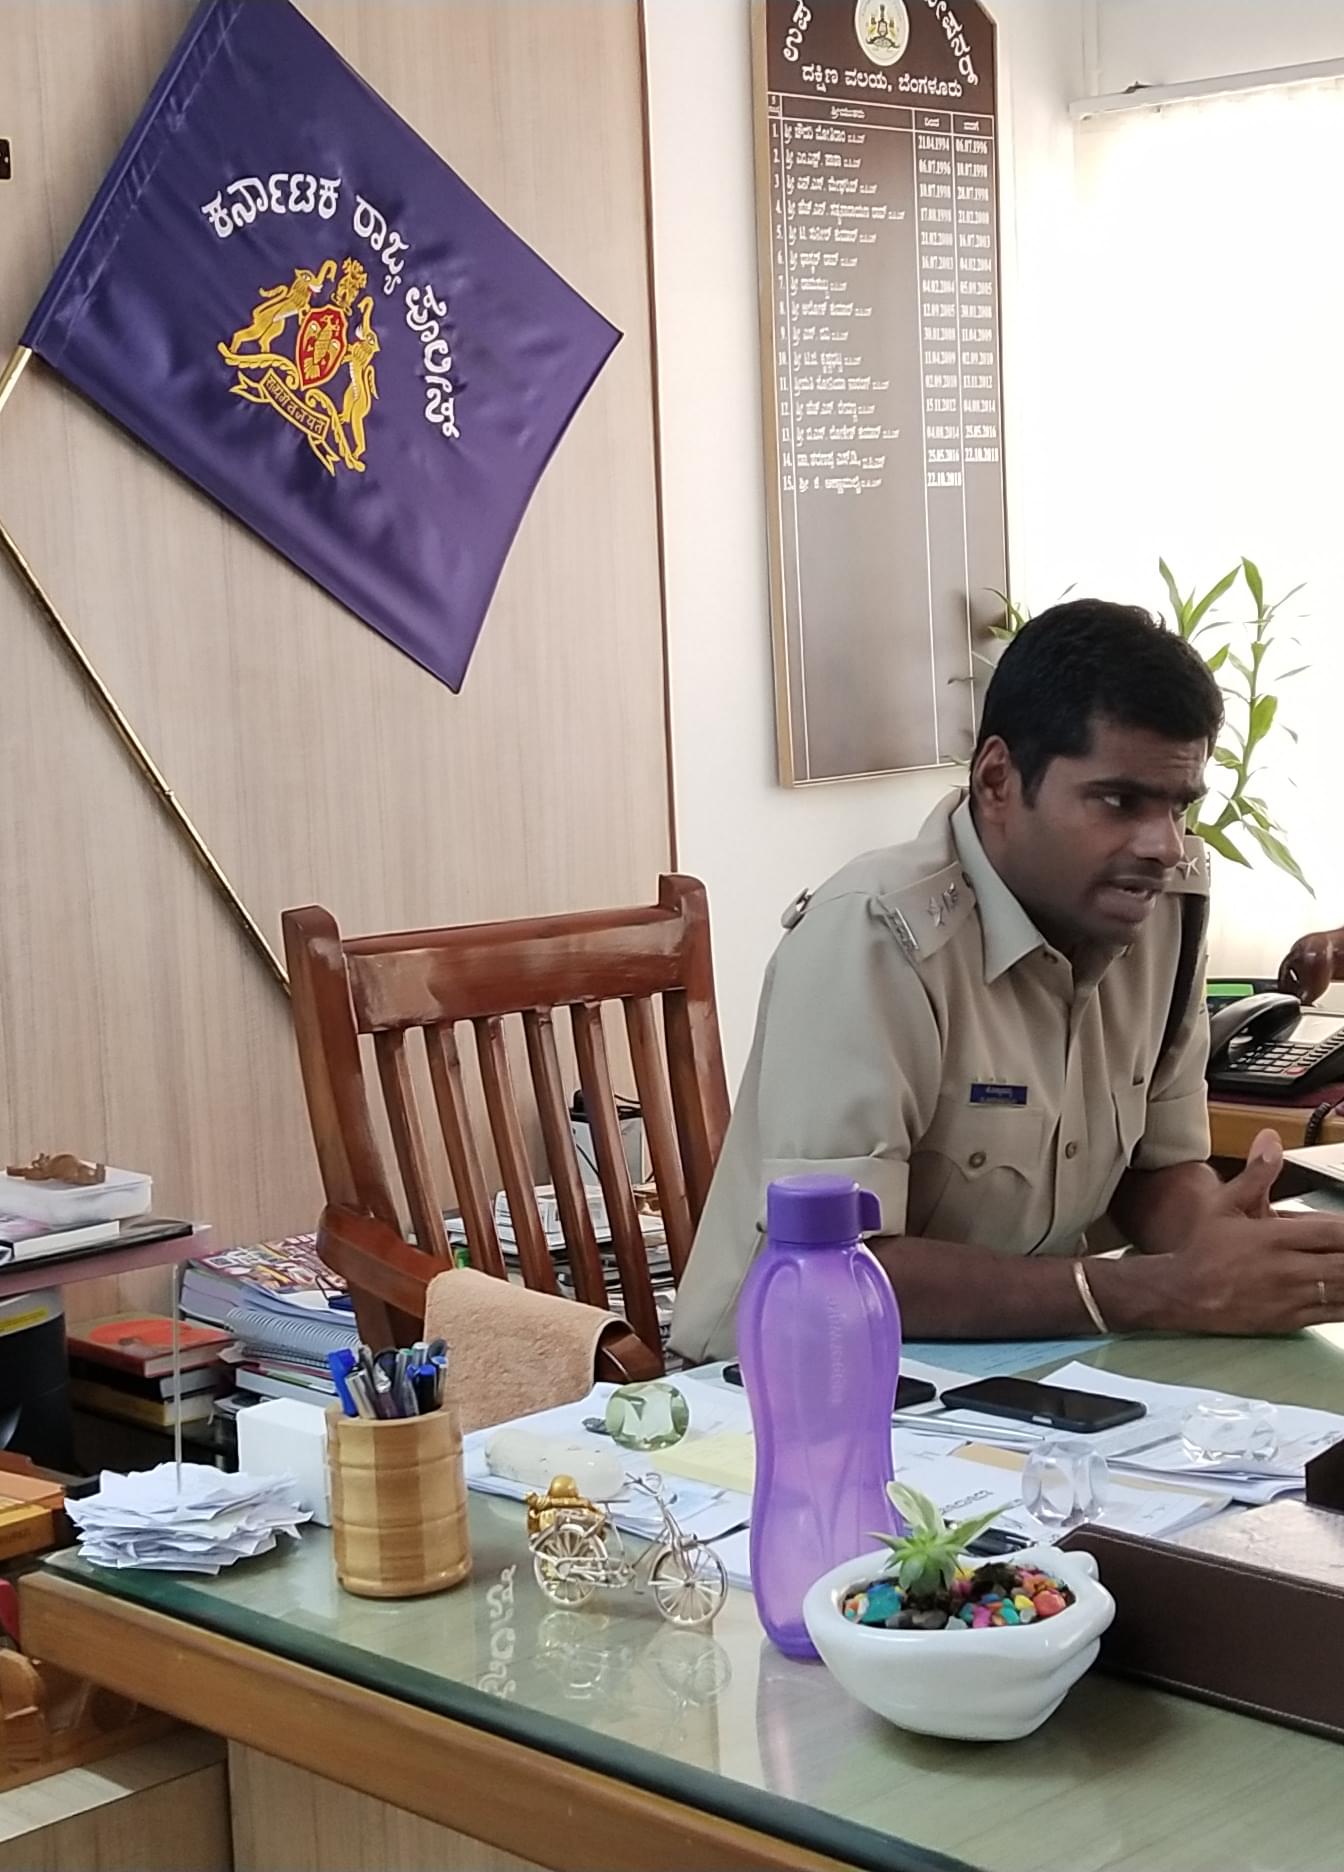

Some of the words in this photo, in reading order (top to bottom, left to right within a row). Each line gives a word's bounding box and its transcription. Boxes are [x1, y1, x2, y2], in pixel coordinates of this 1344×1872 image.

[801, 63, 838, 93] ದಕ್ಷಿಣ
[844, 68, 892, 92] ವಲಯ,
[898, 73, 962, 97] ಬೆಂಗಳೂರು
[201, 174, 342, 238] ಕರ್ನಾಟಕ
[353, 195, 409, 295] ರಾಜ್ಯ
